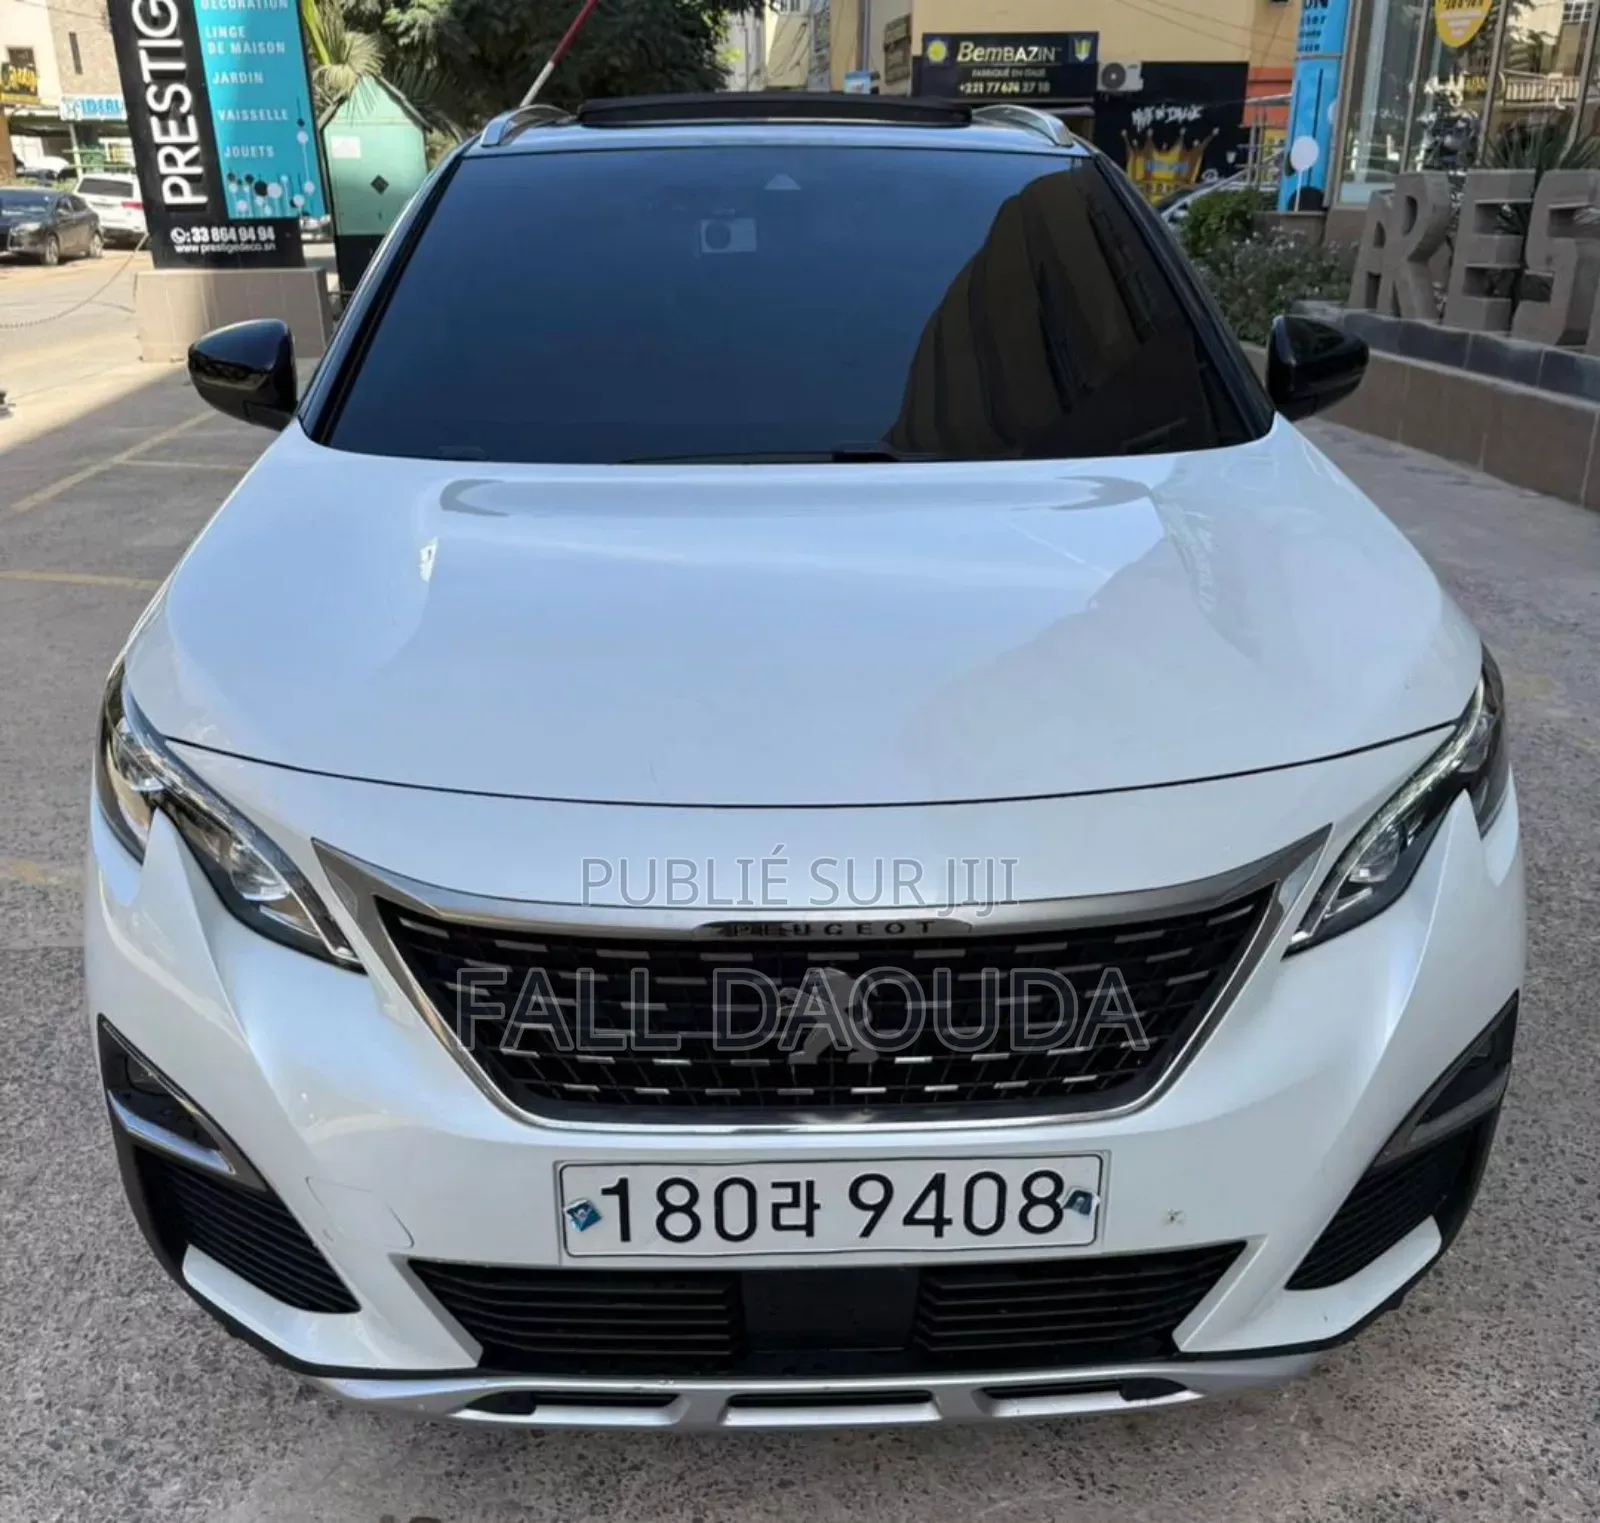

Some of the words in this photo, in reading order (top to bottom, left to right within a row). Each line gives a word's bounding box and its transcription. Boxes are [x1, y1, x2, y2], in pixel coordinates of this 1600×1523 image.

[204, 25, 246, 39] LINGE
[207, 40, 225, 55] DE
[231, 40, 285, 54] MAISON
[212, 71, 264, 85] JARDIN
[218, 108, 289, 121] VAISSELLE
[223, 144, 275, 158] JOUETS
[733, 920, 935, 938] PEUGEOT
[600, 1176, 821, 1244] 180라
[848, 1169, 1066, 1239] 9408
